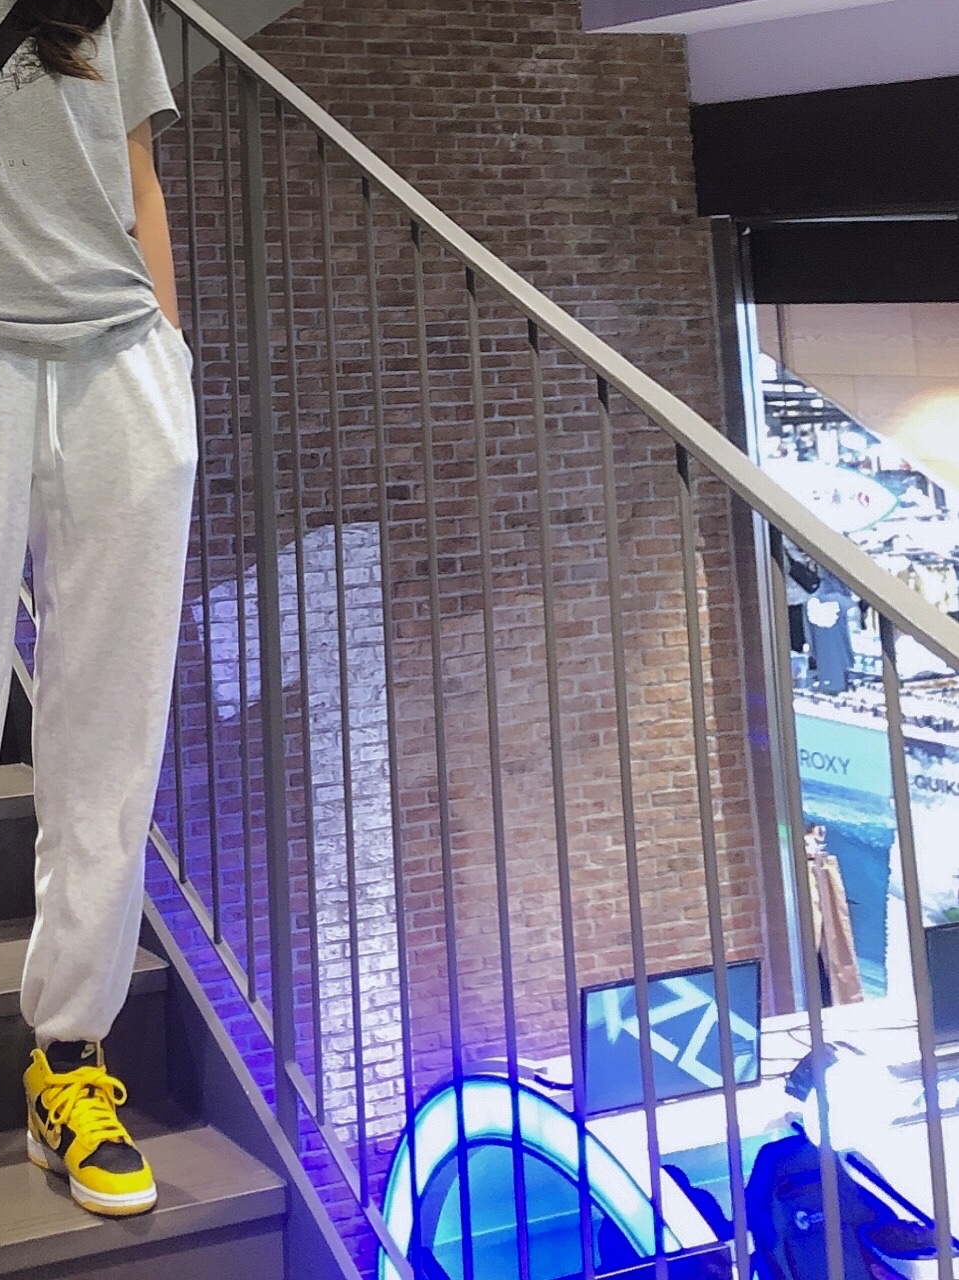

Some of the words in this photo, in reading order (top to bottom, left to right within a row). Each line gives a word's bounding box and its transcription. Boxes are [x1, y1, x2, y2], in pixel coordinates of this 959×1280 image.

[799, 748, 850, 776] ROXY
[913, 774, 959, 797] QUIK
[191, 520, 410, 1144] 1
